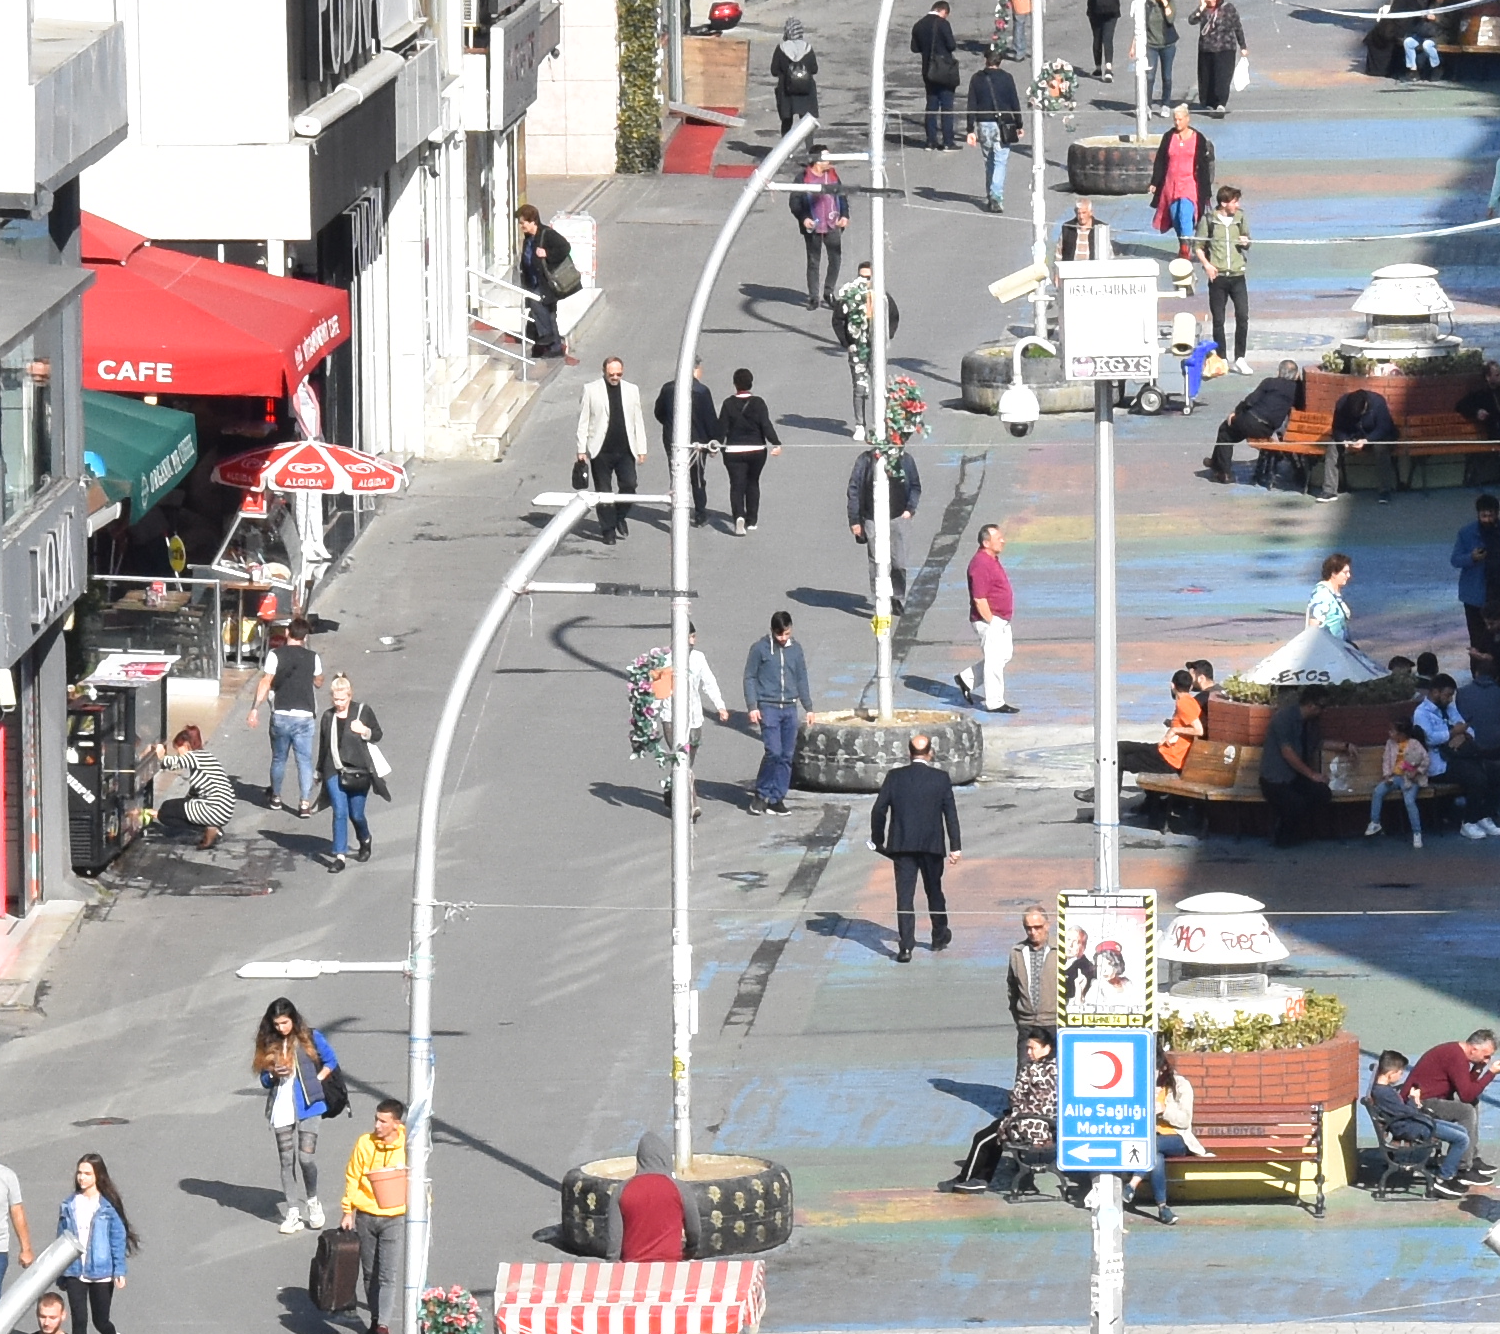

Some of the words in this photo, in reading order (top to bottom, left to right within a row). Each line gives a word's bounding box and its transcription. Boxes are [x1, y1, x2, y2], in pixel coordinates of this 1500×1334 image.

[97, 359, 173, 384] CAFE
[1095, 356, 1152, 372] KGYS
[284, 477, 327, 489] ALGIDA
[357, 476, 390, 489] ALGIDA
[1064, 1103, 1092, 1117] Aile
[1095, 1103, 1147, 1121] Sağlığı
[1076, 1121, 1135, 1135] Merkezi
